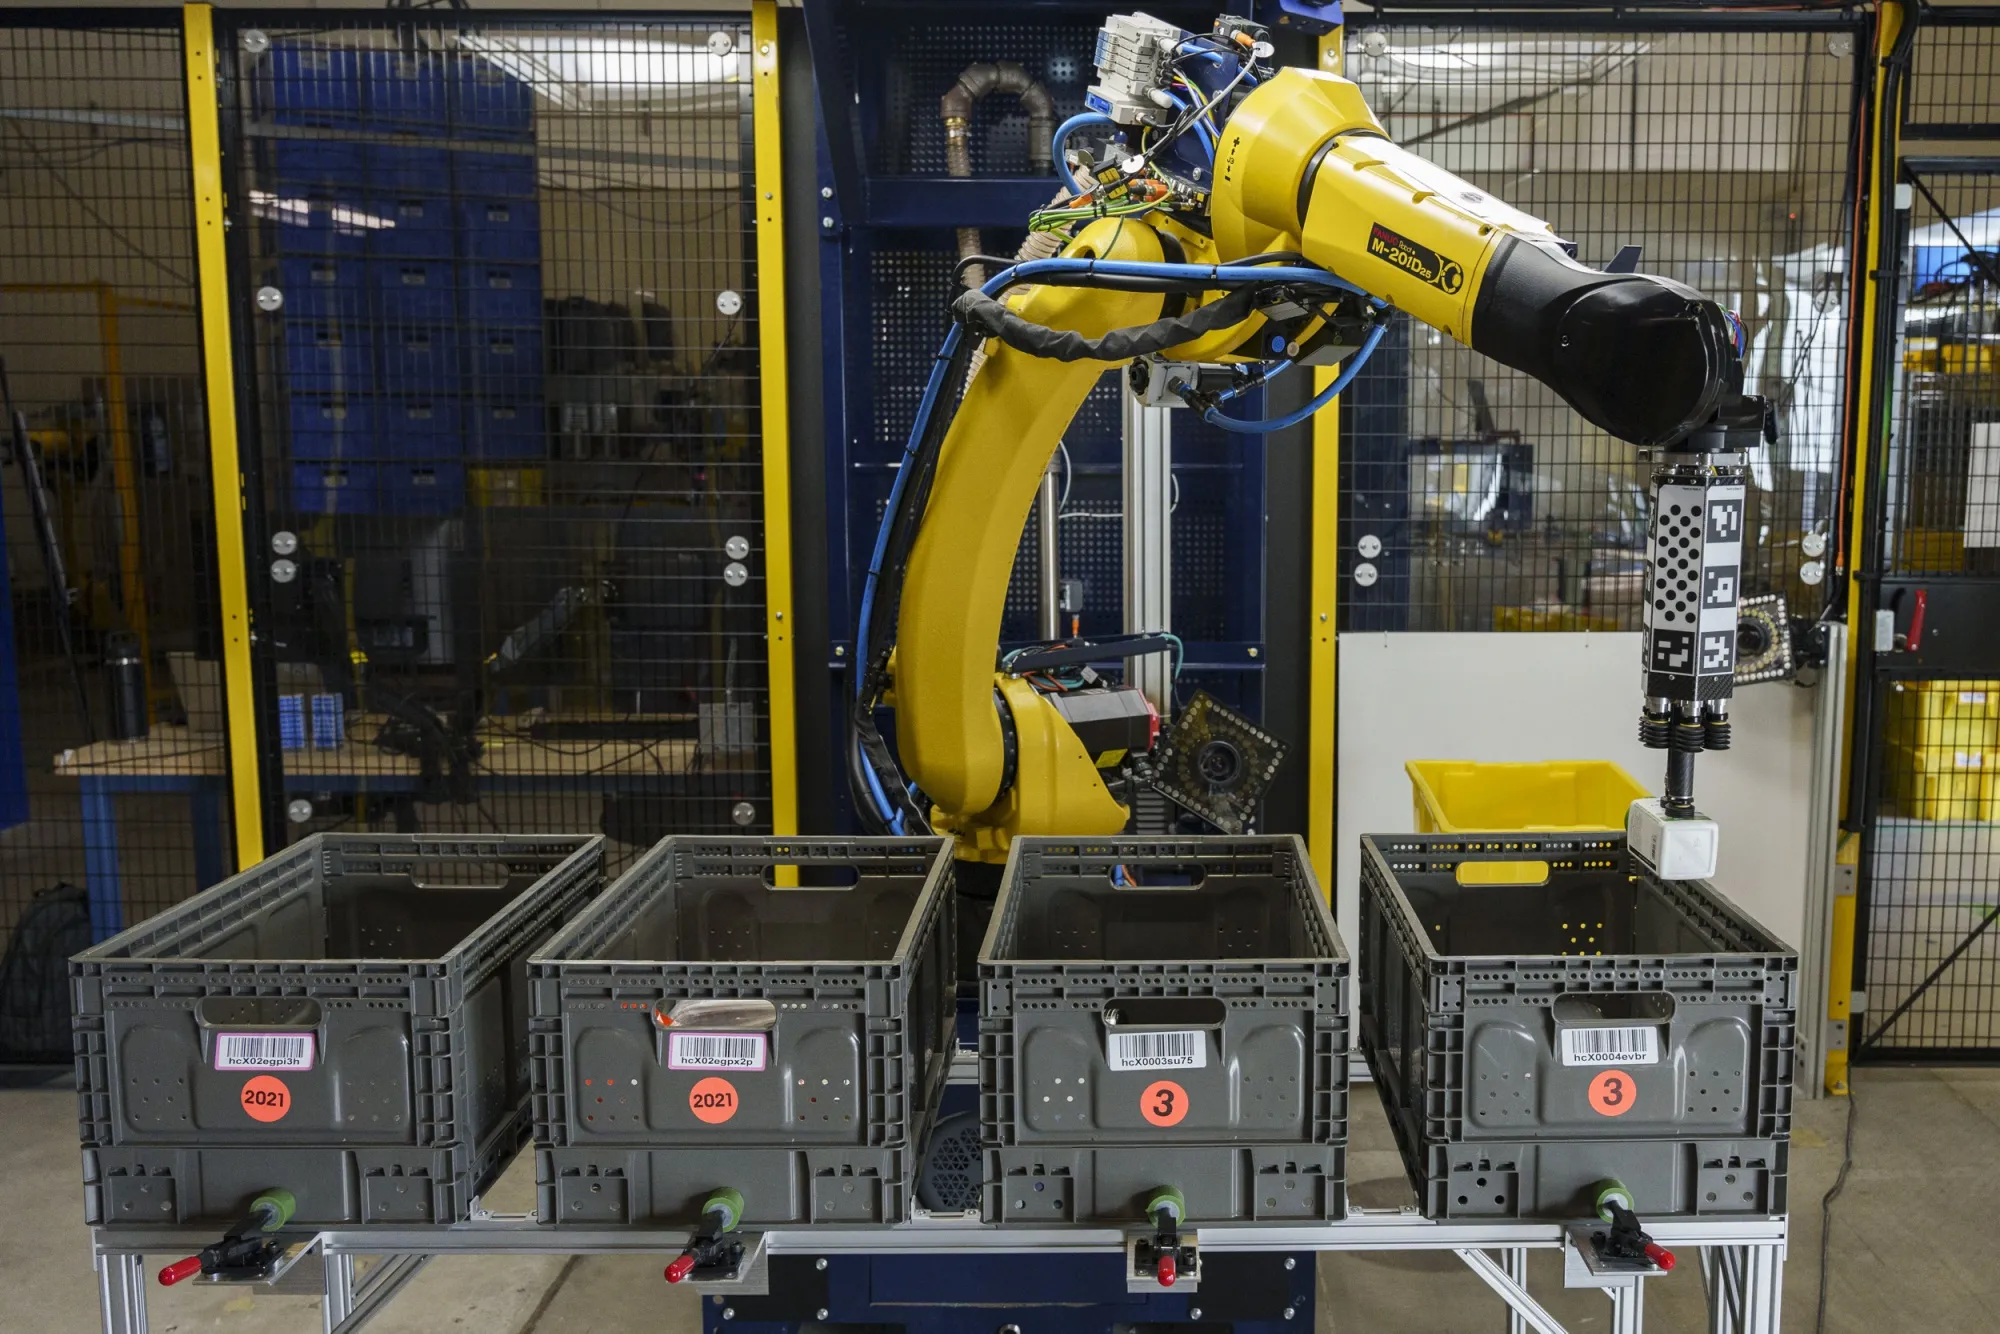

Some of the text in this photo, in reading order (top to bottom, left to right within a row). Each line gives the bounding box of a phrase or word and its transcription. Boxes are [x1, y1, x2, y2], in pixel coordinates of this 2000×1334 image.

[228, 1057, 300, 1067] hcX02egpi3h
[681, 1057, 753, 1067] hcX02egpx2p
[1121, 1056, 1193, 1067] hcX0003su75
[1574, 1052, 1647, 1062] hcX0004evbr
[1603, 1077, 1623, 1106] 3
[244, 1089, 284, 1108] 2021
[693, 1092, 732, 1108] 2021
[1153, 1088, 1175, 1117] 3
